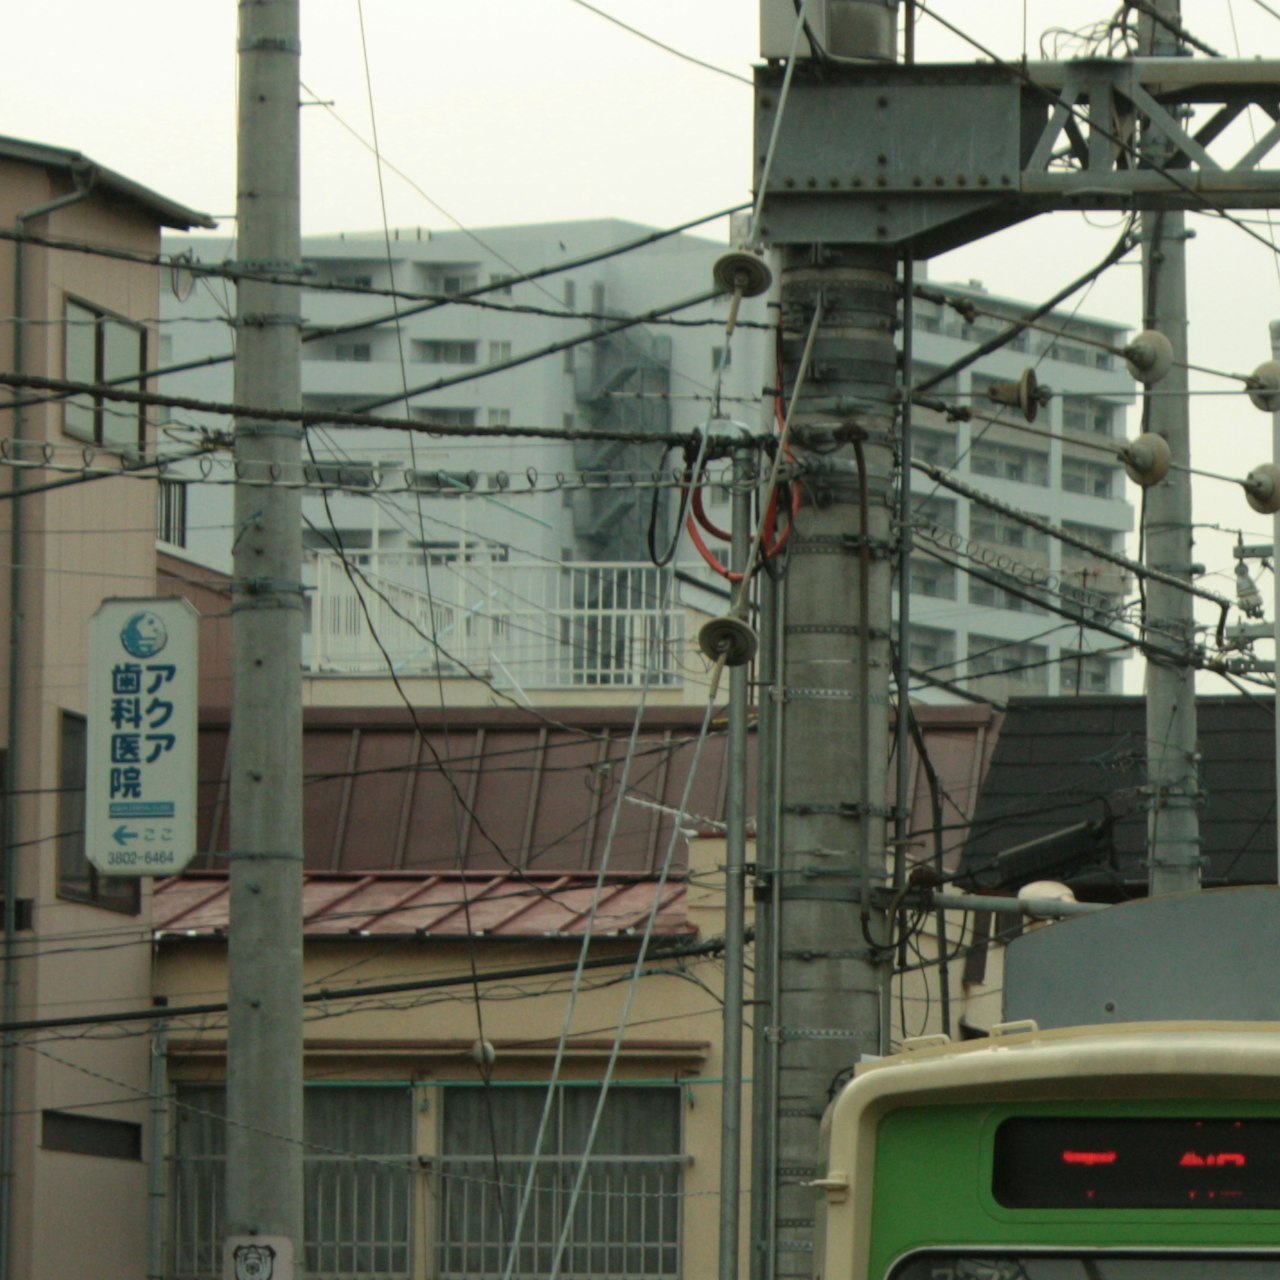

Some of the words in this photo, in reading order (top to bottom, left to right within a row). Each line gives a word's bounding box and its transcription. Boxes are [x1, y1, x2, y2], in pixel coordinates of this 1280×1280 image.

[109, 662, 142, 799] 歯科医院
[145, 664, 176, 763] アクア
[144, 828, 172, 841] ここ
